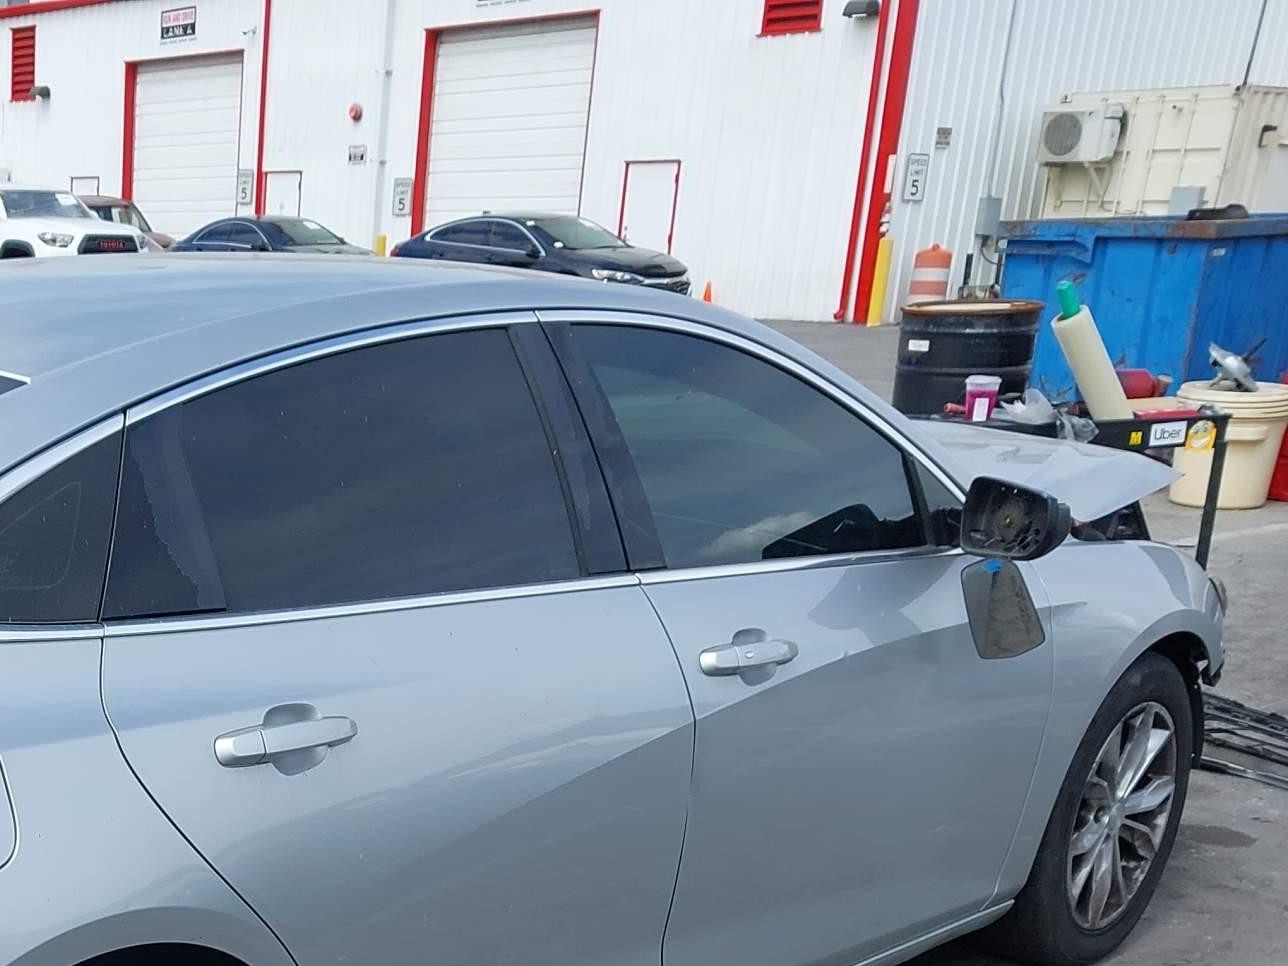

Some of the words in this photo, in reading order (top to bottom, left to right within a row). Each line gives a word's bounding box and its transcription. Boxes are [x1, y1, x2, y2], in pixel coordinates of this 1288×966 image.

[910, 159, 928, 167] SPEED
[910, 168, 924, 177] LIMIT
[241, 187, 248, 200] 5
[910, 179, 920, 196] 5
[398, 198, 406, 211] 5
[1154, 427, 1182, 440] Uber
